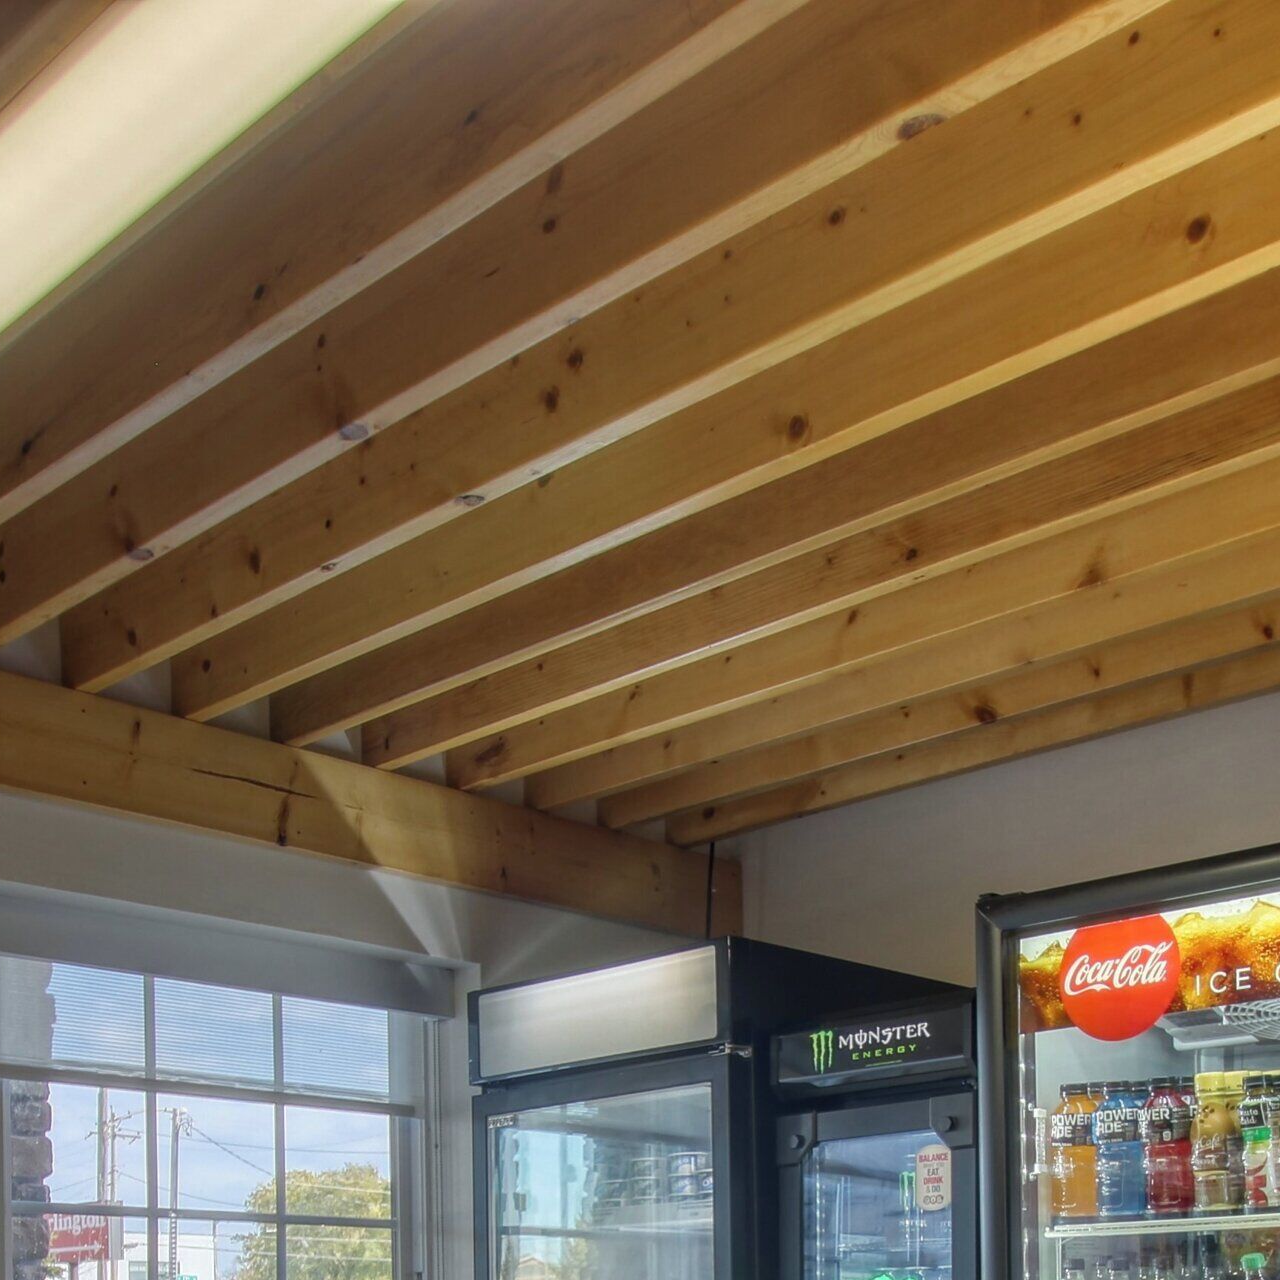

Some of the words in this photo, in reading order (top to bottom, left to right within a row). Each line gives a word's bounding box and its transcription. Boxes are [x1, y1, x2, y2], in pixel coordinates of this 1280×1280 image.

[1064, 940, 1174, 997] Coca-Cola
[1194, 966, 1252, 997] ICE
[838, 1022, 931, 1050] MONSTER
[852, 1044, 917, 1061] ENERGY
[1051, 1114, 1091, 1127] POWER
[1051, 1126, 1072, 1138] ADE
[1096, 1121, 1122, 1135] ADE
[918, 1152, 949, 1163] BALANCE
[927, 1167, 939, 1177] EAT
[923, 1176, 944, 1186] DRINK
[47, 1213, 107, 1236] rlington
